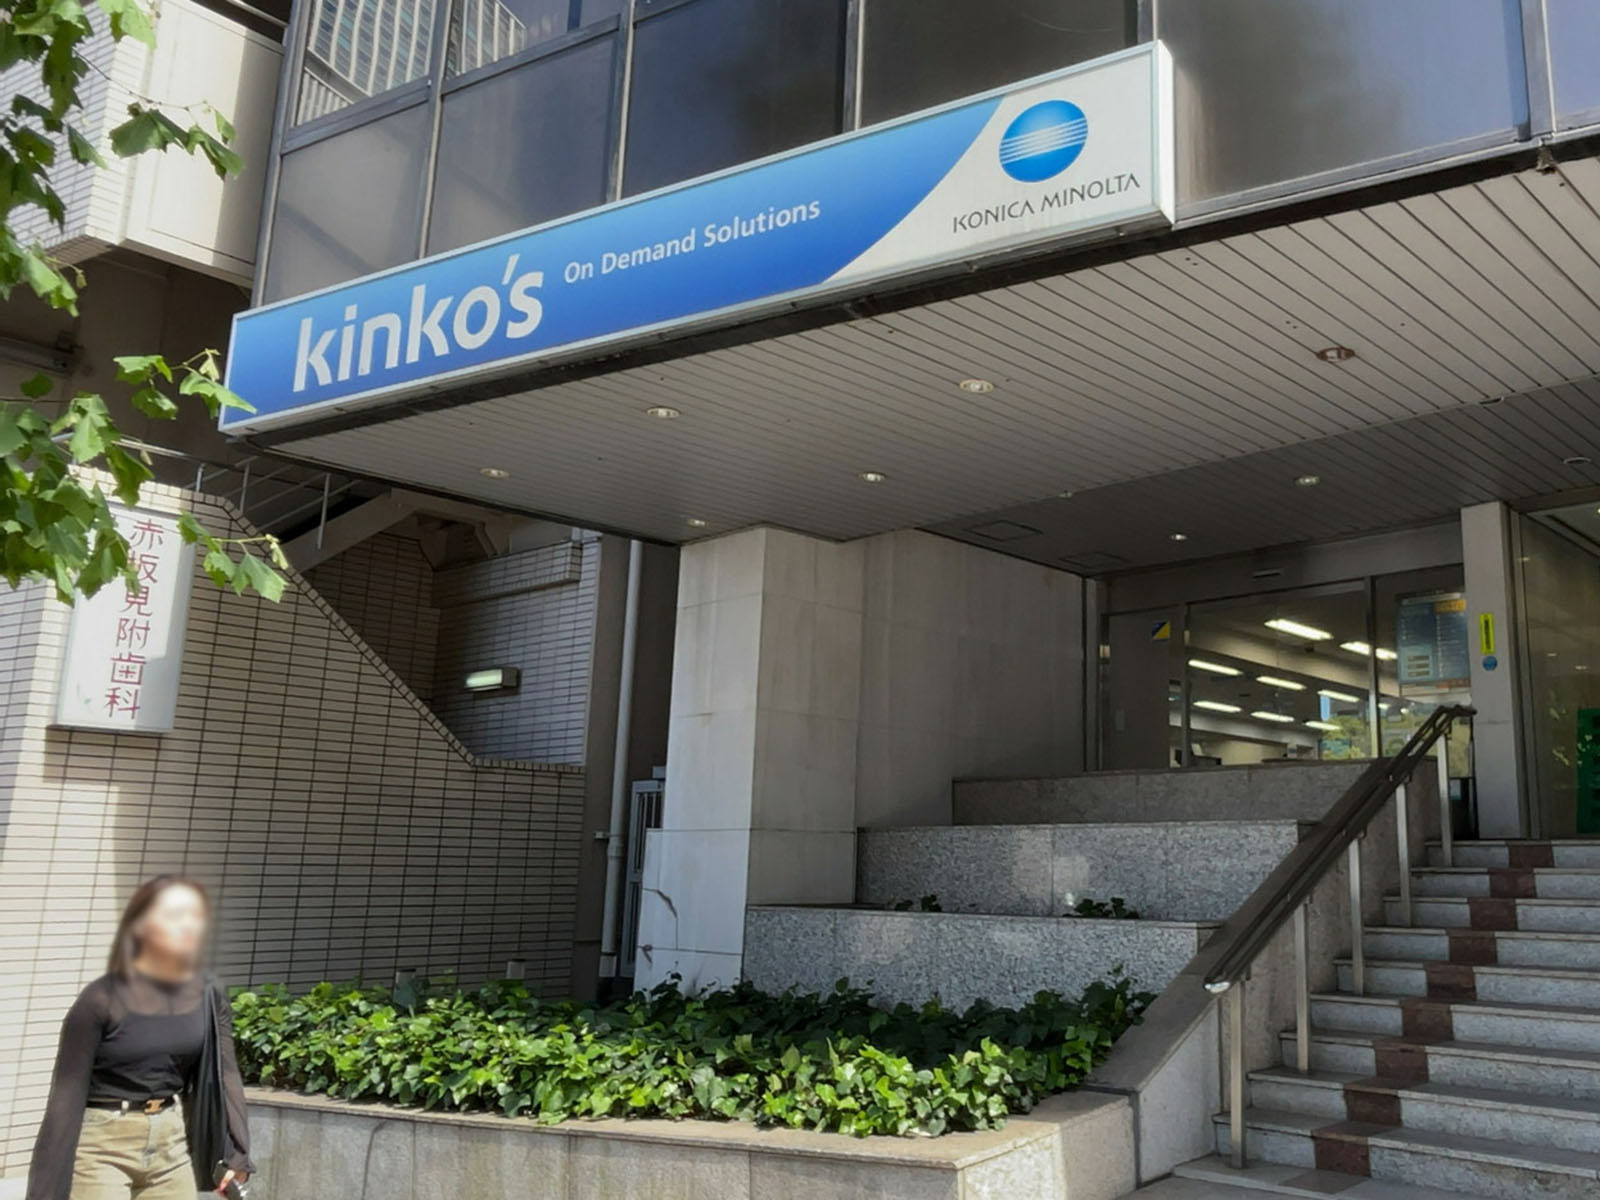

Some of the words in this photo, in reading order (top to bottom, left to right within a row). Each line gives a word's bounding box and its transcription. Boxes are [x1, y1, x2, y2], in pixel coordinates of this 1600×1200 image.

[564, 261, 593, 284] On
[601, 228, 696, 275] Demand
[703, 200, 820, 248] Solutions
[953, 200, 1035, 234] KONICA
[1041, 173, 1140, 212] MINOLTA
[293, 253, 544, 393] kinko's
[104, 518, 164, 720] 赤坂見附歯科
